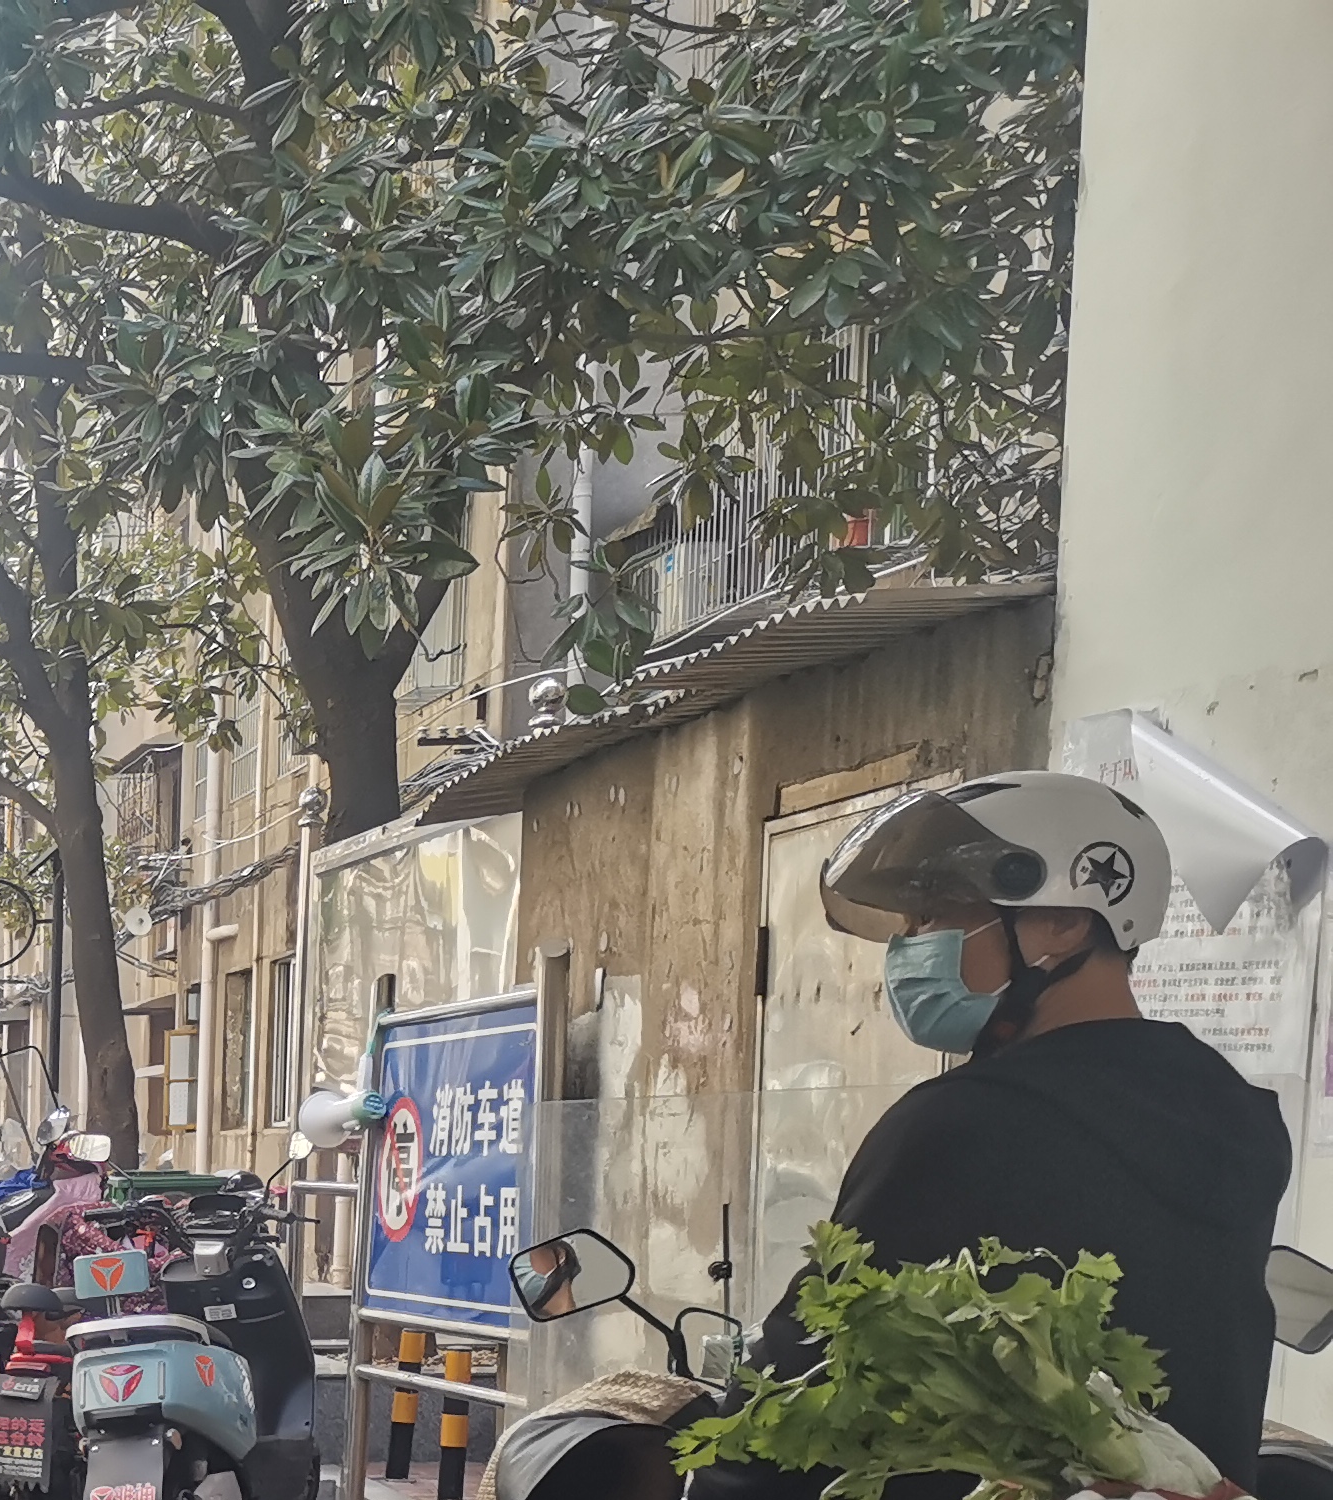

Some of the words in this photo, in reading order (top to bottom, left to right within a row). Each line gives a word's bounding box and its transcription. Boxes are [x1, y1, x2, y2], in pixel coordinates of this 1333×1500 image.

[429, 1078, 525, 1157] 消防车道
[425, 1182, 521, 1259] 禁止占用
